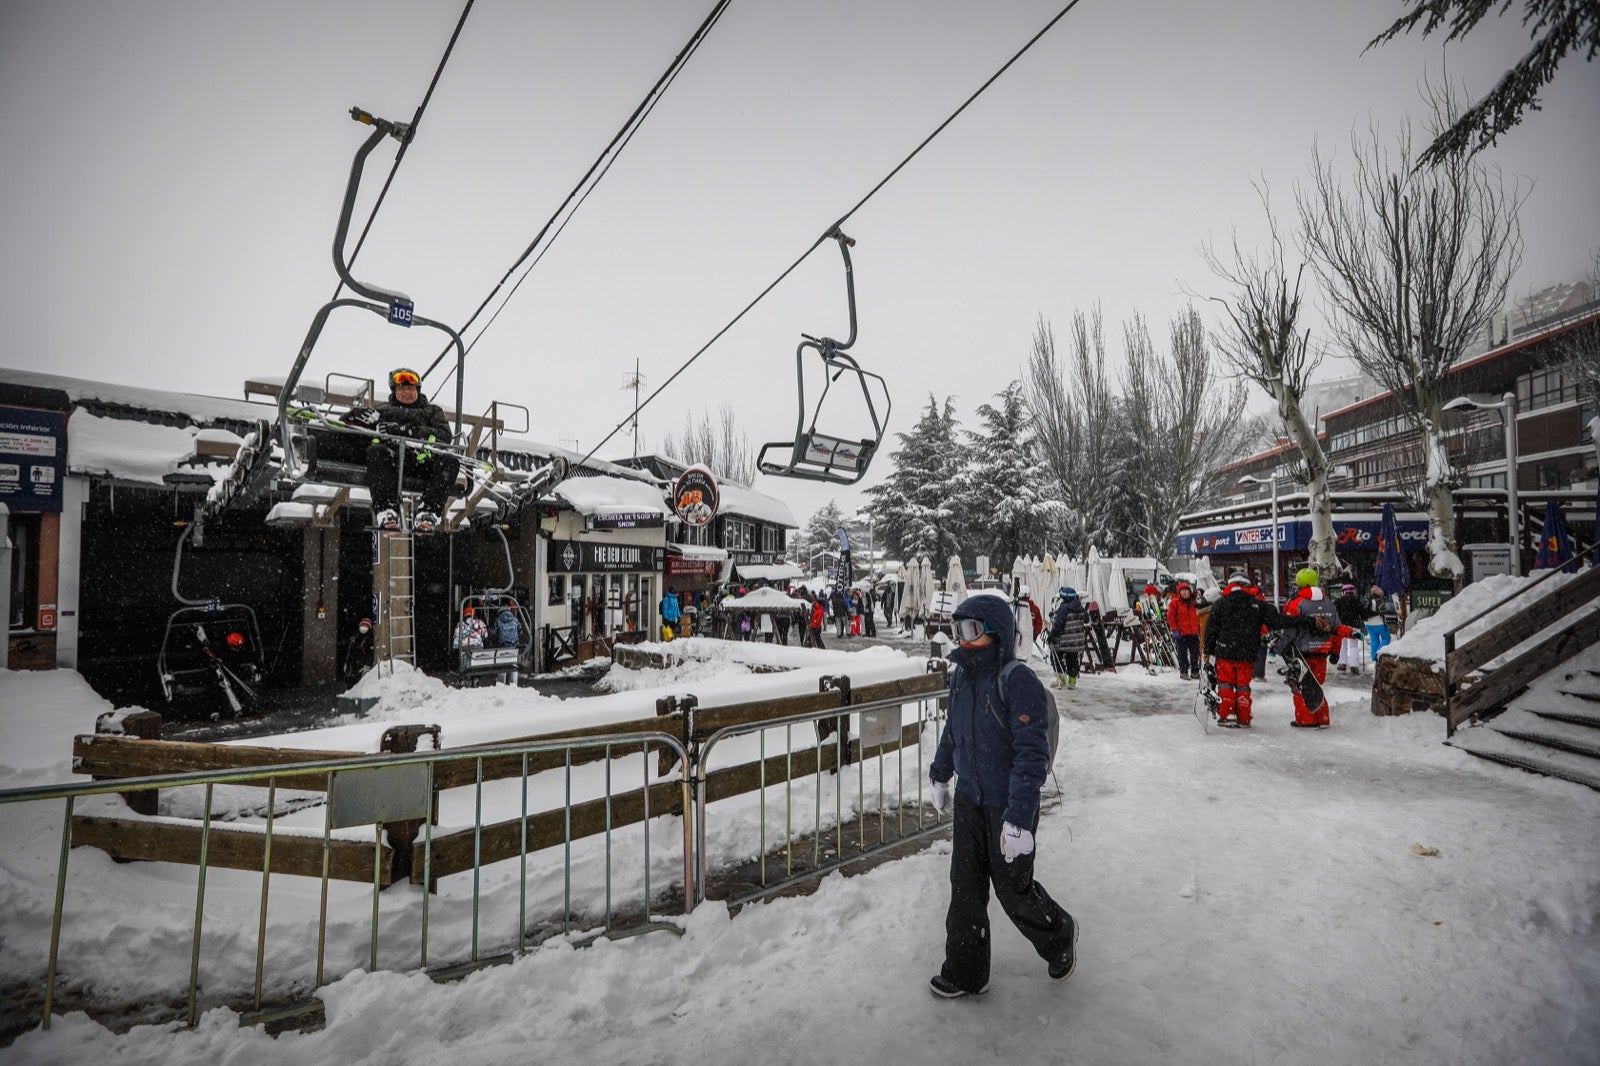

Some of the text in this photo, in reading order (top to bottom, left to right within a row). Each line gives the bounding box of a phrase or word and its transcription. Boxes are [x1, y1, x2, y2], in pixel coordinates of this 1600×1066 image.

[392, 307, 411, 322] 105
[1337, 528, 1371, 544] Rio
[1417, 596, 1441, 607] SUPER
